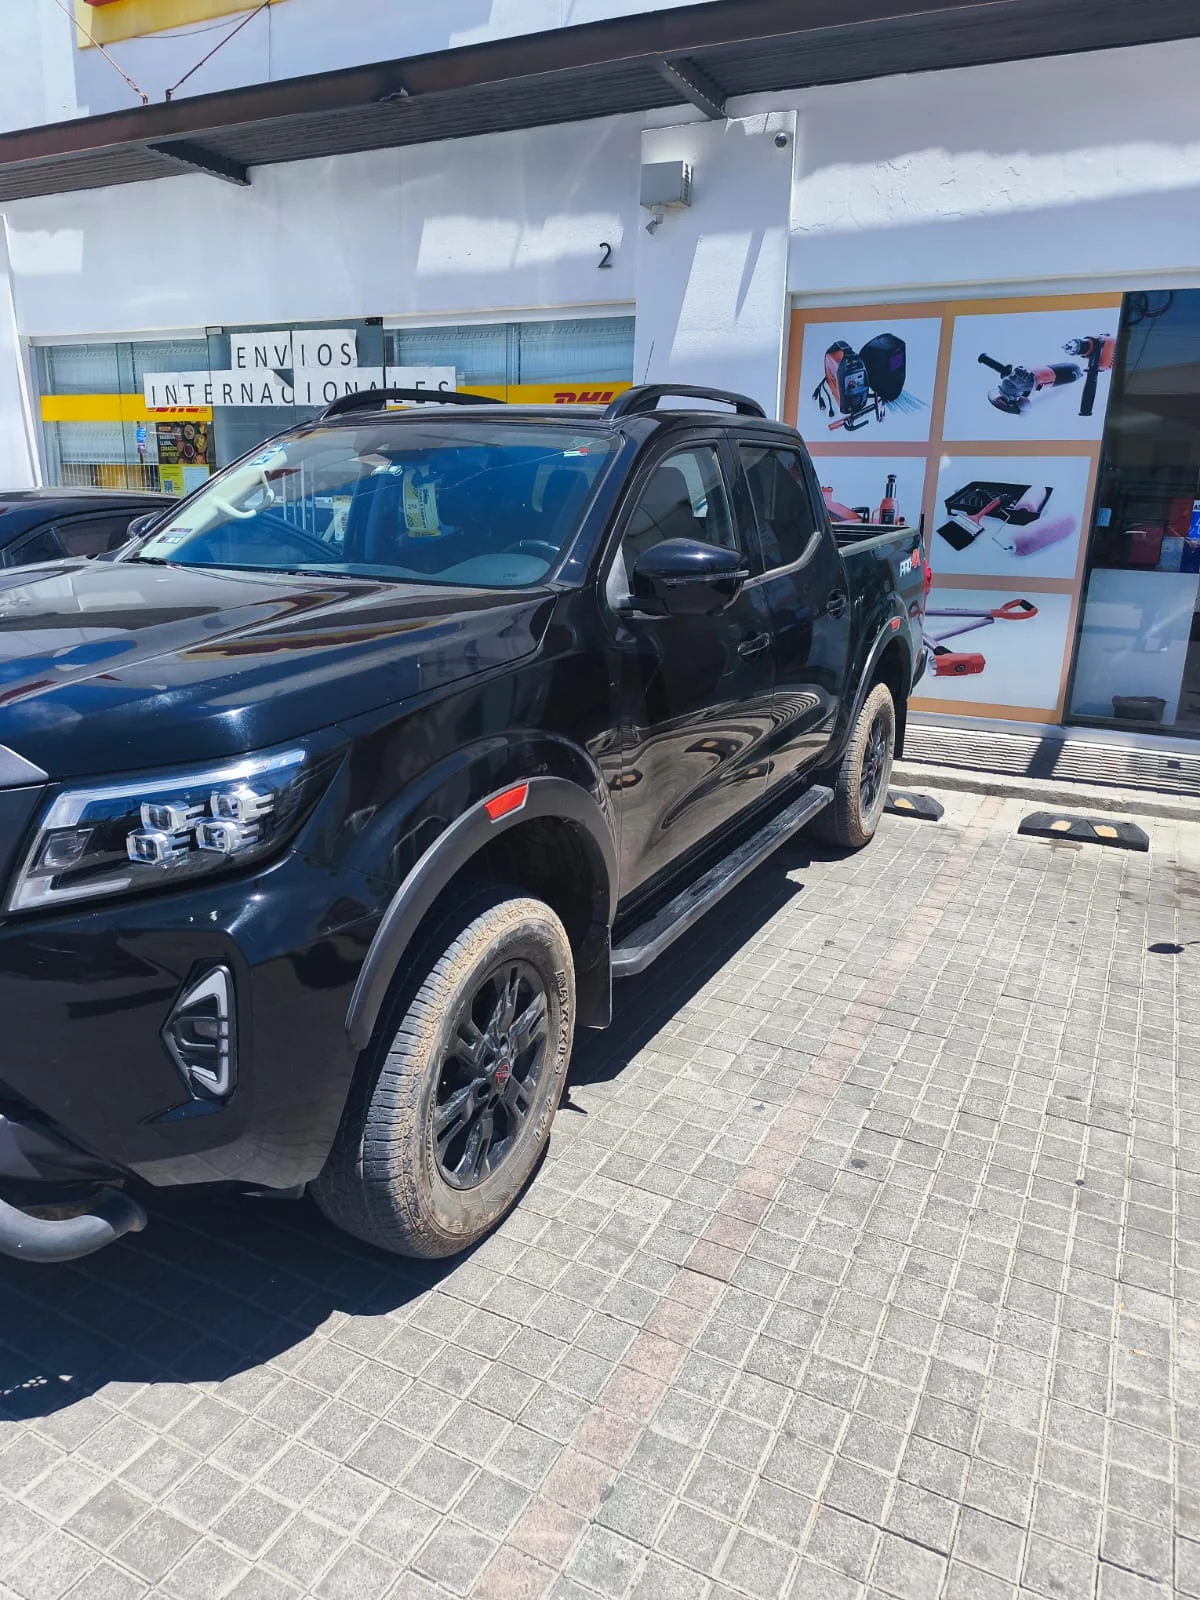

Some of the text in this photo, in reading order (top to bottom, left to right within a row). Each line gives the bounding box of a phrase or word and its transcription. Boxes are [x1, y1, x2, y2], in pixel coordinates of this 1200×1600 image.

[597, 242, 612, 269] 2
[237, 343, 352, 369] ENVIOS
[554, 970, 570, 1076] MAXXIS
